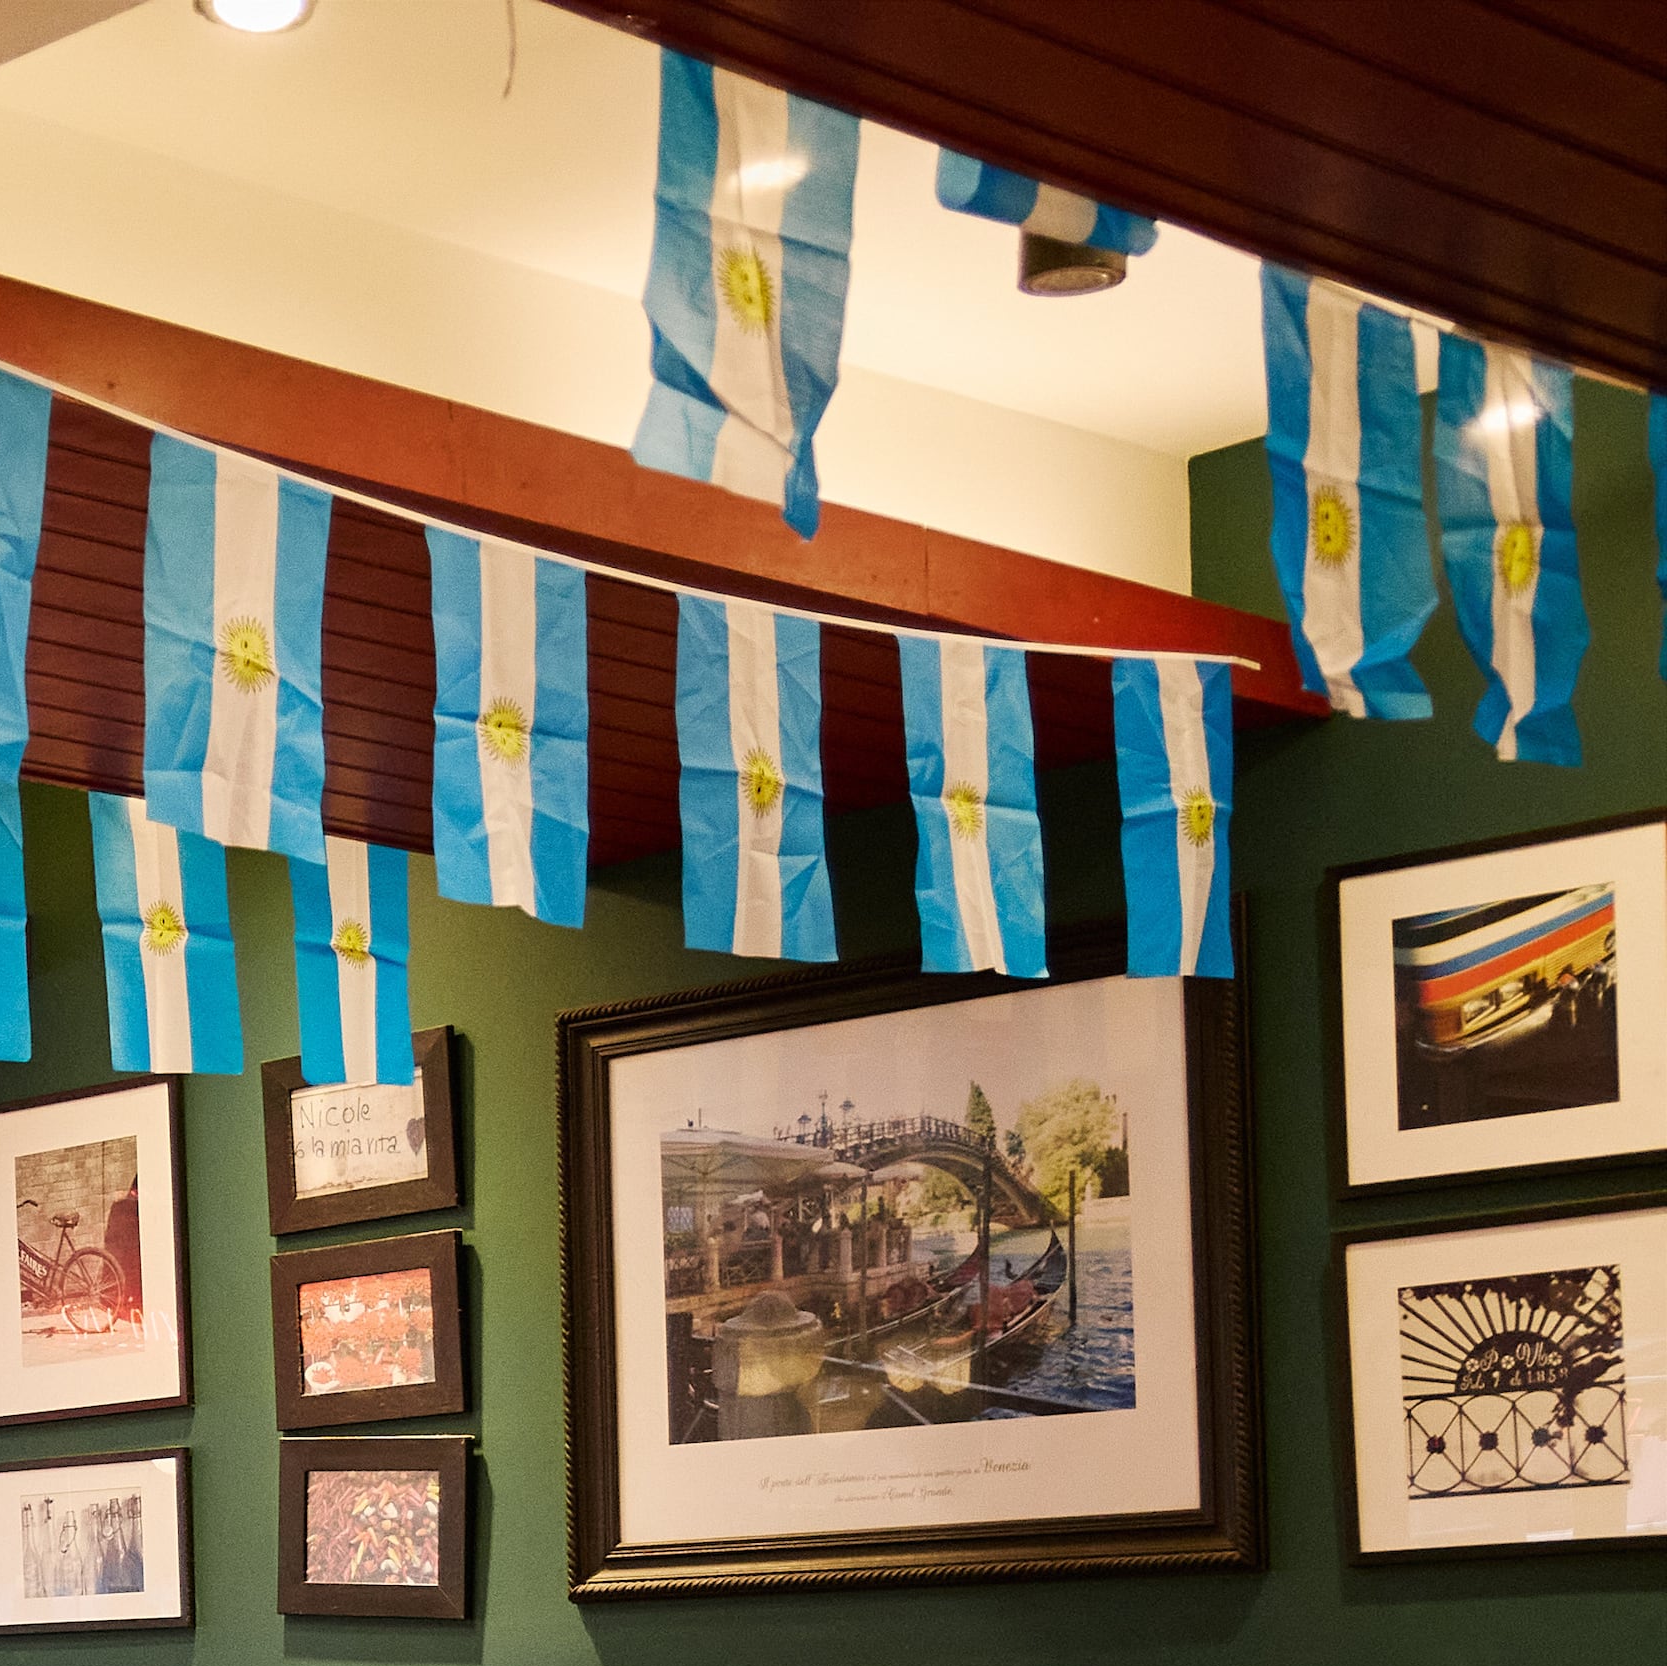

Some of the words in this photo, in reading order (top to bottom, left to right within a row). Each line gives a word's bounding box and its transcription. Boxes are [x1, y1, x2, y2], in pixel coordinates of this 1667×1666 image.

[300, 1097, 371, 1129] Nicole
[311, 1135, 325, 1158] la
[981, 1457, 1030, 1474] Venezia
